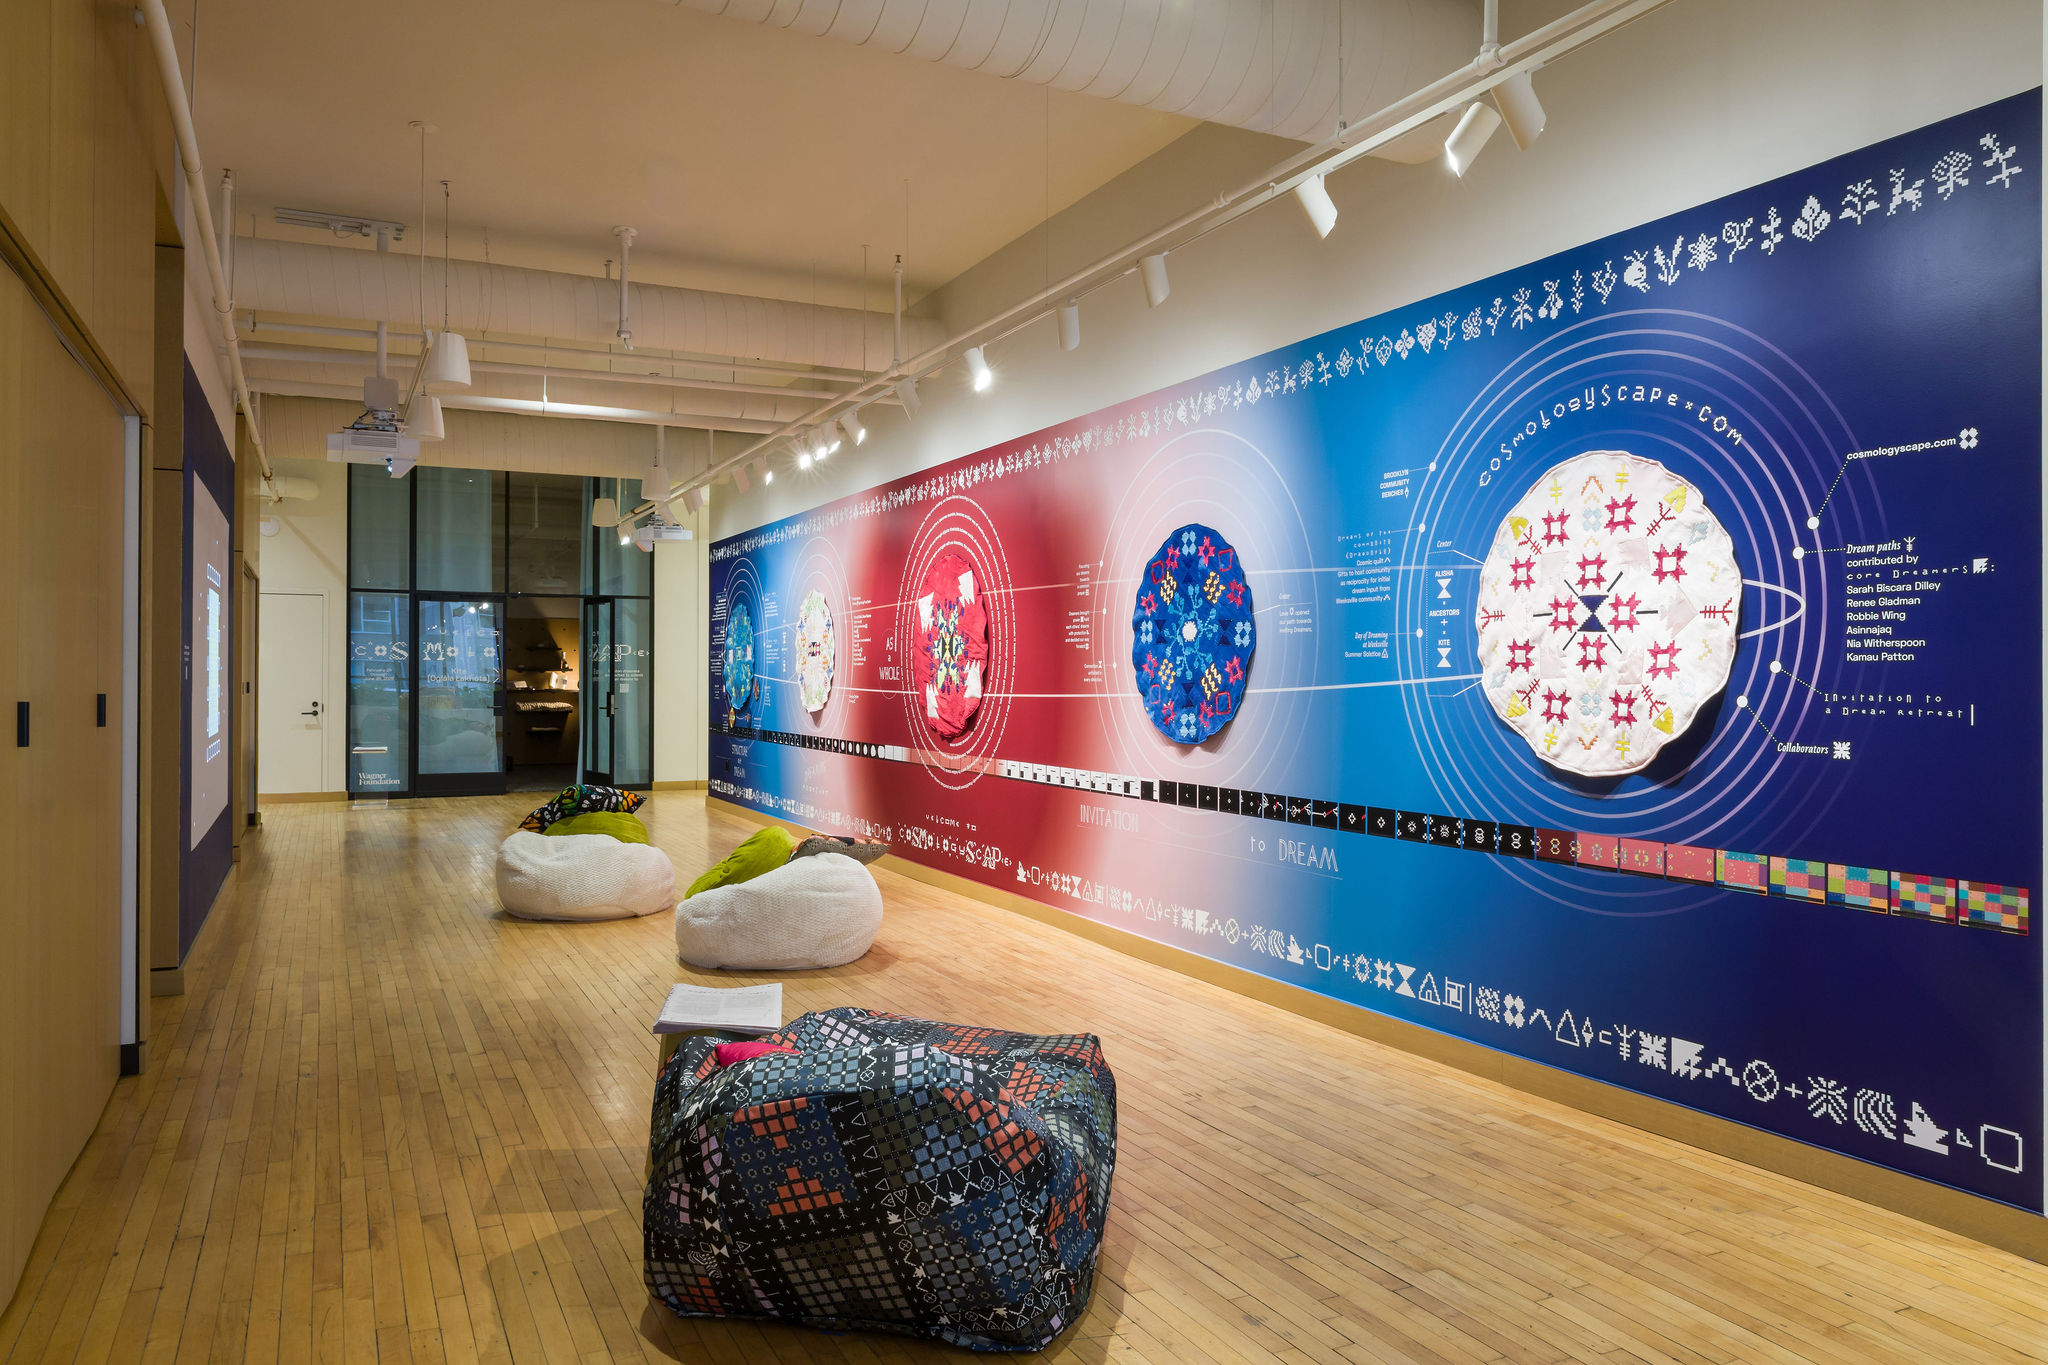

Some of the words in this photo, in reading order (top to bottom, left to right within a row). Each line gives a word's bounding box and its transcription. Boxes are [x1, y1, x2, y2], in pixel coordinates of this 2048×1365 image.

[1846, 438, 1957, 460] cosmologyscape.com
[1384, 469, 1409, 480] BROOKLYN
[1380, 478, 1410, 489] COMMUNITY
[1436, 540, 1453, 548] Center
[1846, 543, 1875, 554] Dream
[1877, 539, 1902, 554] paths
[1846, 555, 1904, 568] contributed
[1905, 554, 1919, 565] by
[1434, 569, 1454, 578] ALISHA
[1846, 572, 1881, 580] core
[1846, 585, 1874, 595] Sarah
[1876, 583, 1912, 593] Biscara
[1914, 581, 1941, 592] Dilley
[1846, 598, 1876, 608] Renee
[1878, 597, 1921, 607] Gladman
[1429, 609, 1460, 617] ANCESTORS
[1846, 612, 1879, 621] Robbie
[1881, 611, 1906, 622] Wing
[1846, 625, 1892, 636] Asinnajaq
[885, 636, 894, 651] AS
[1846, 639, 1862, 648] Nia
[1863, 638, 1926, 649] Witherspoon
[1846, 652, 1879, 662] Kamau
[1881, 652, 1915, 661] Patton
[878, 666, 900, 681] WHOLE
[1824, 693, 1912, 703] Invitation
[1925, 694, 1942, 703] to
[1825, 707, 1831, 715] a
[1842, 707, 1886, 716] Dream
[1898, 708, 1963, 718] Retreat
[1777, 742, 1829, 755] Collaborators
[358, 772, 387, 780] Wagner
[359, 777, 401, 786] Foundation
[1080, 803, 1140, 833] INVITATION
[1250, 836, 1266, 853] to
[1278, 838, 1339, 872] DREAM
